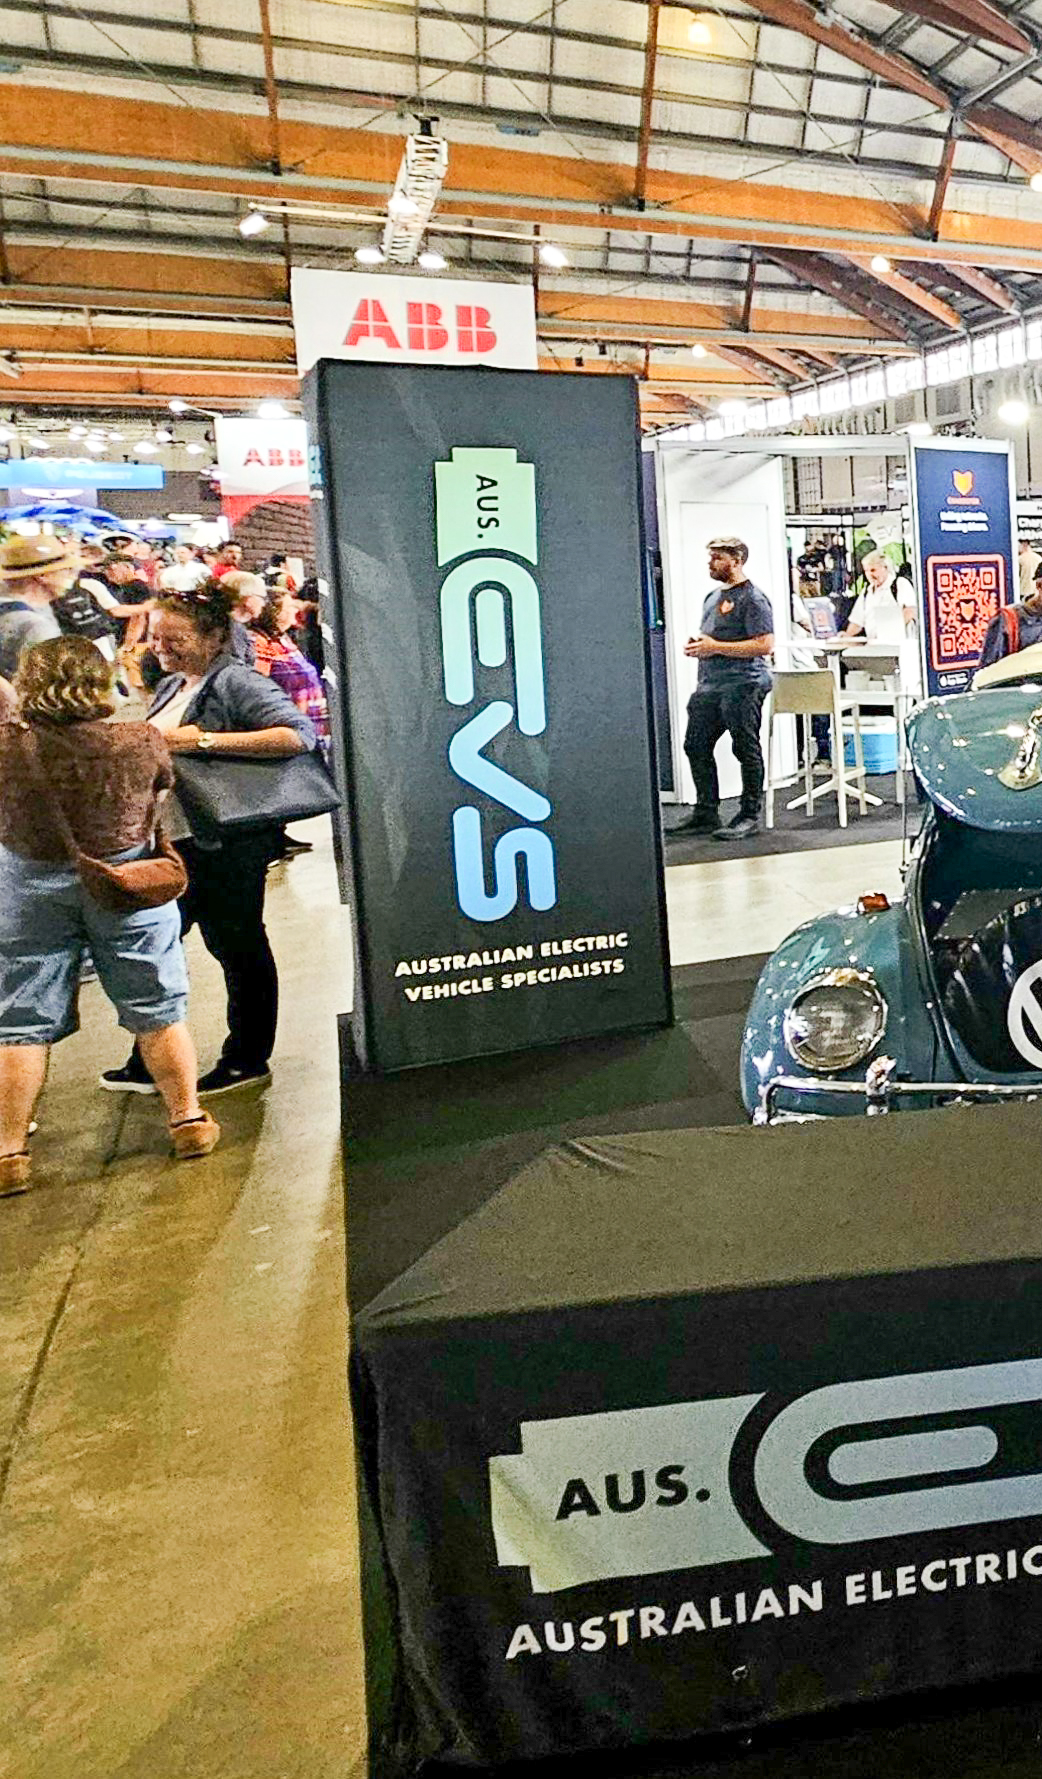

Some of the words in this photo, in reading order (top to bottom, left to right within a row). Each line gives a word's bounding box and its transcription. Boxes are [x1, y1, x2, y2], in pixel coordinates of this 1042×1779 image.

[343, 299, 497, 353] ABB
[243, 448, 305, 467] ABB
[475, 474, 499, 539] AUS.
[394, 944, 533, 977] AUSTRALIAN
[540, 932, 629, 958] ELECTRIC
[404, 976, 494, 1002] VEHICLE
[501, 958, 625, 989] SPECIALISTS
[555, 1464, 711, 1521] AUS.
[505, 1580, 823, 1660] AUSTRALIAN
